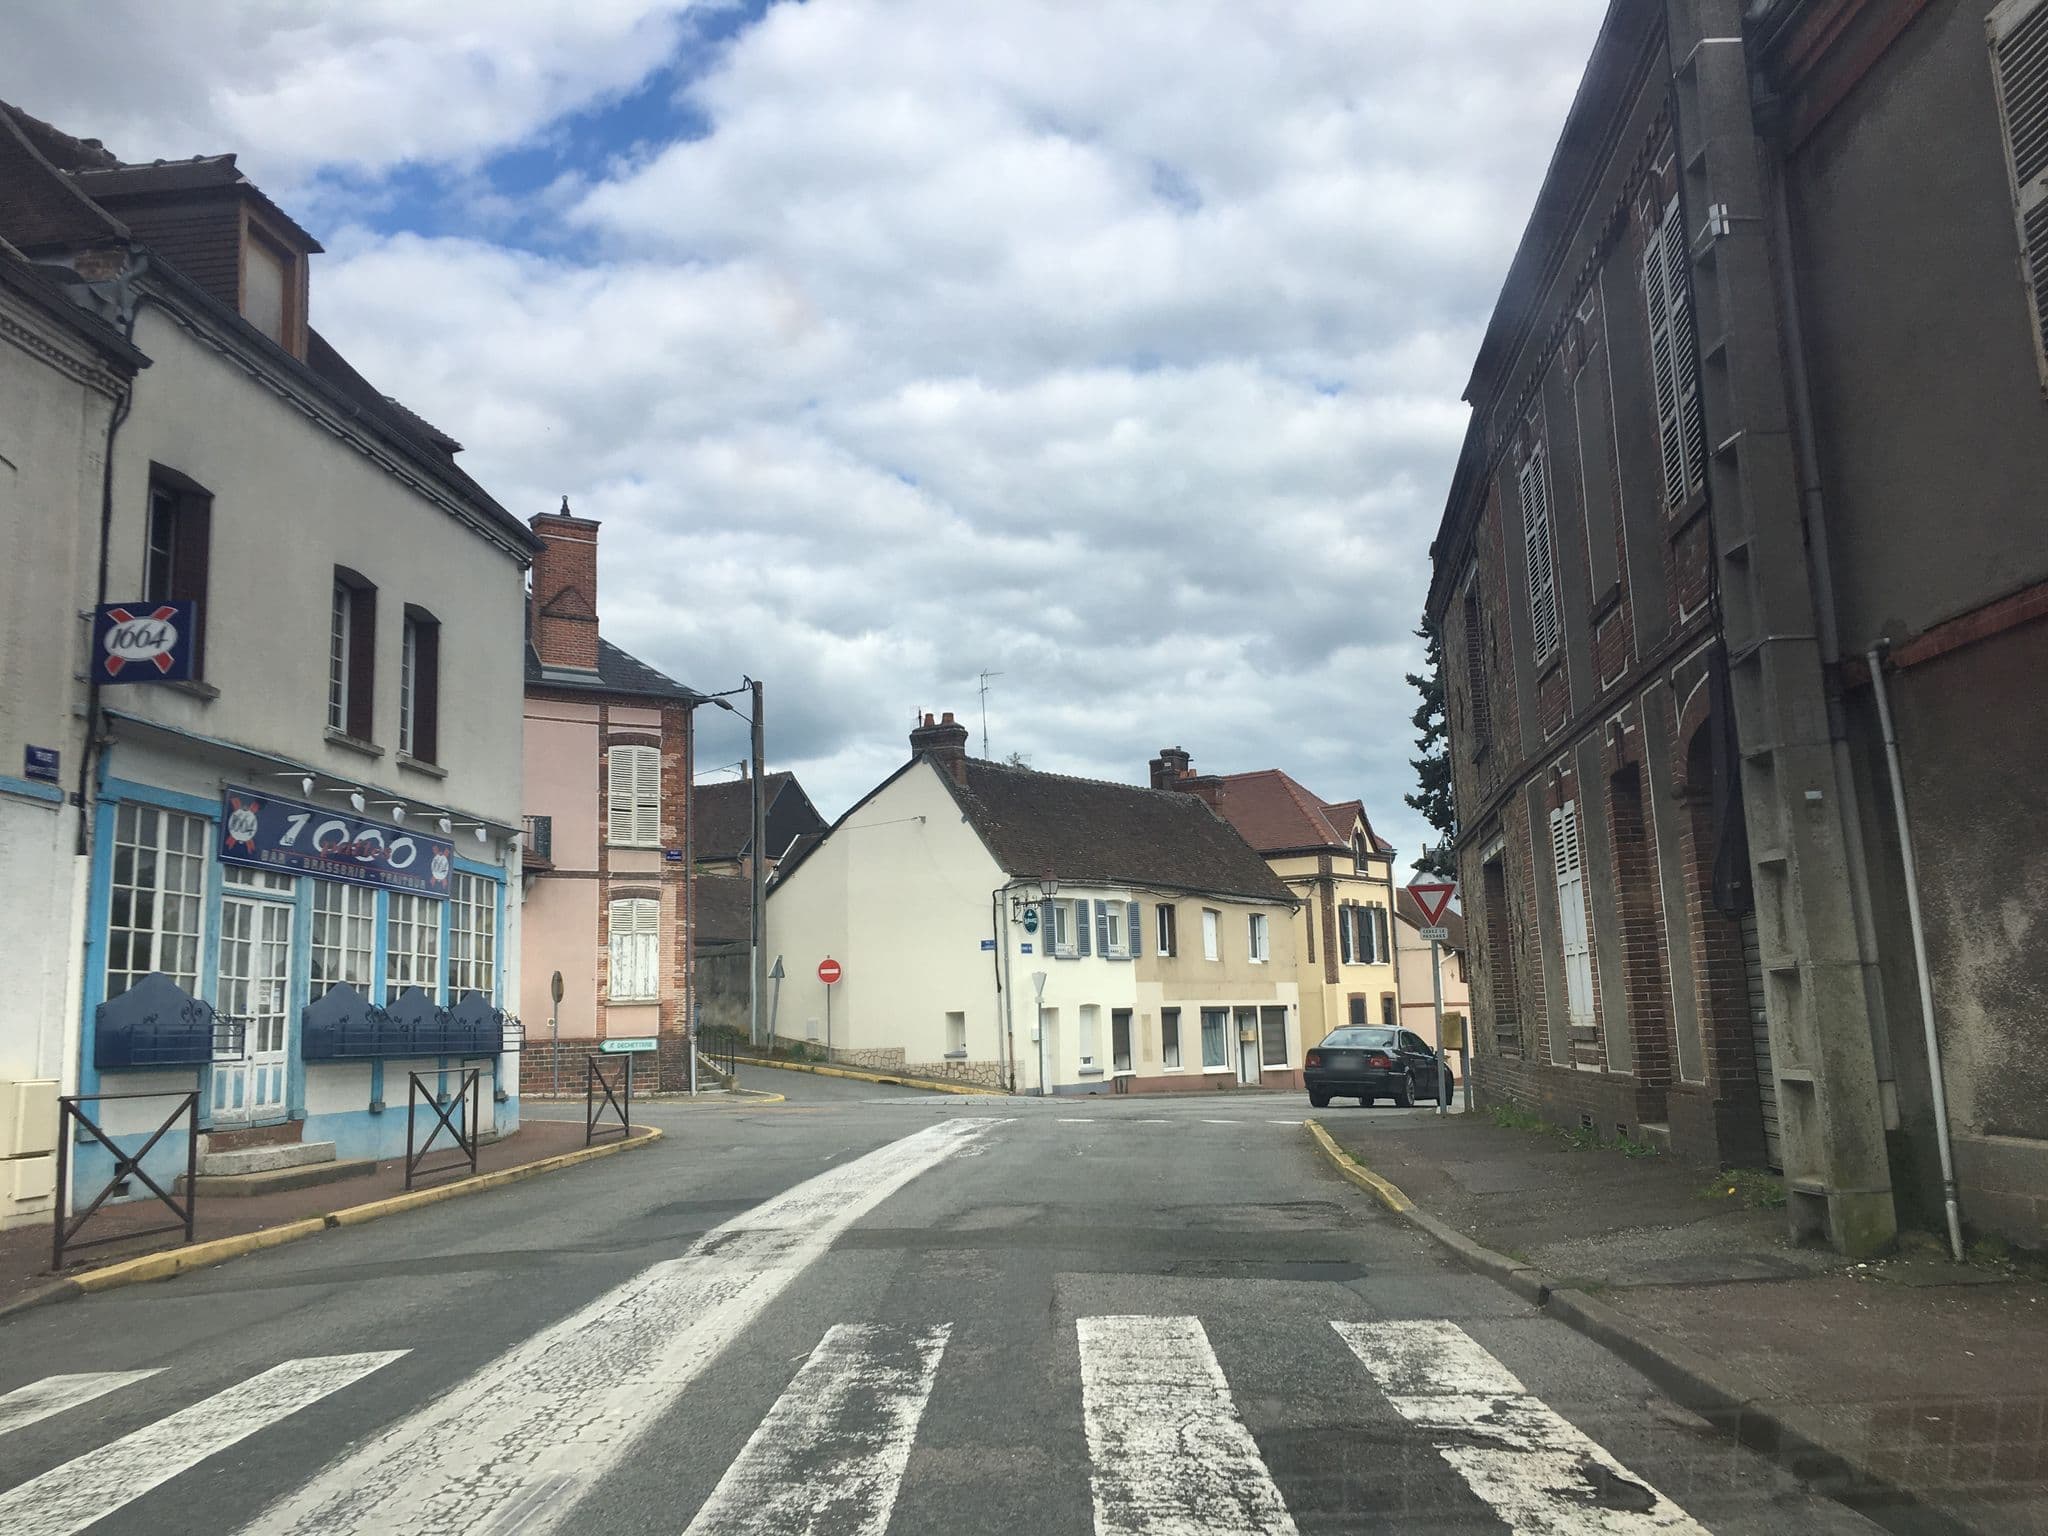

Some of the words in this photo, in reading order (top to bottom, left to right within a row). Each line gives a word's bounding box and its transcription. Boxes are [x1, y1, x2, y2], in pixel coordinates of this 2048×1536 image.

[110, 623, 169, 649] 1664
[280, 813, 417, 869] 1000
[260, 849, 286, 865] BAR
[303, 857, 366, 880] BRASSERIE
